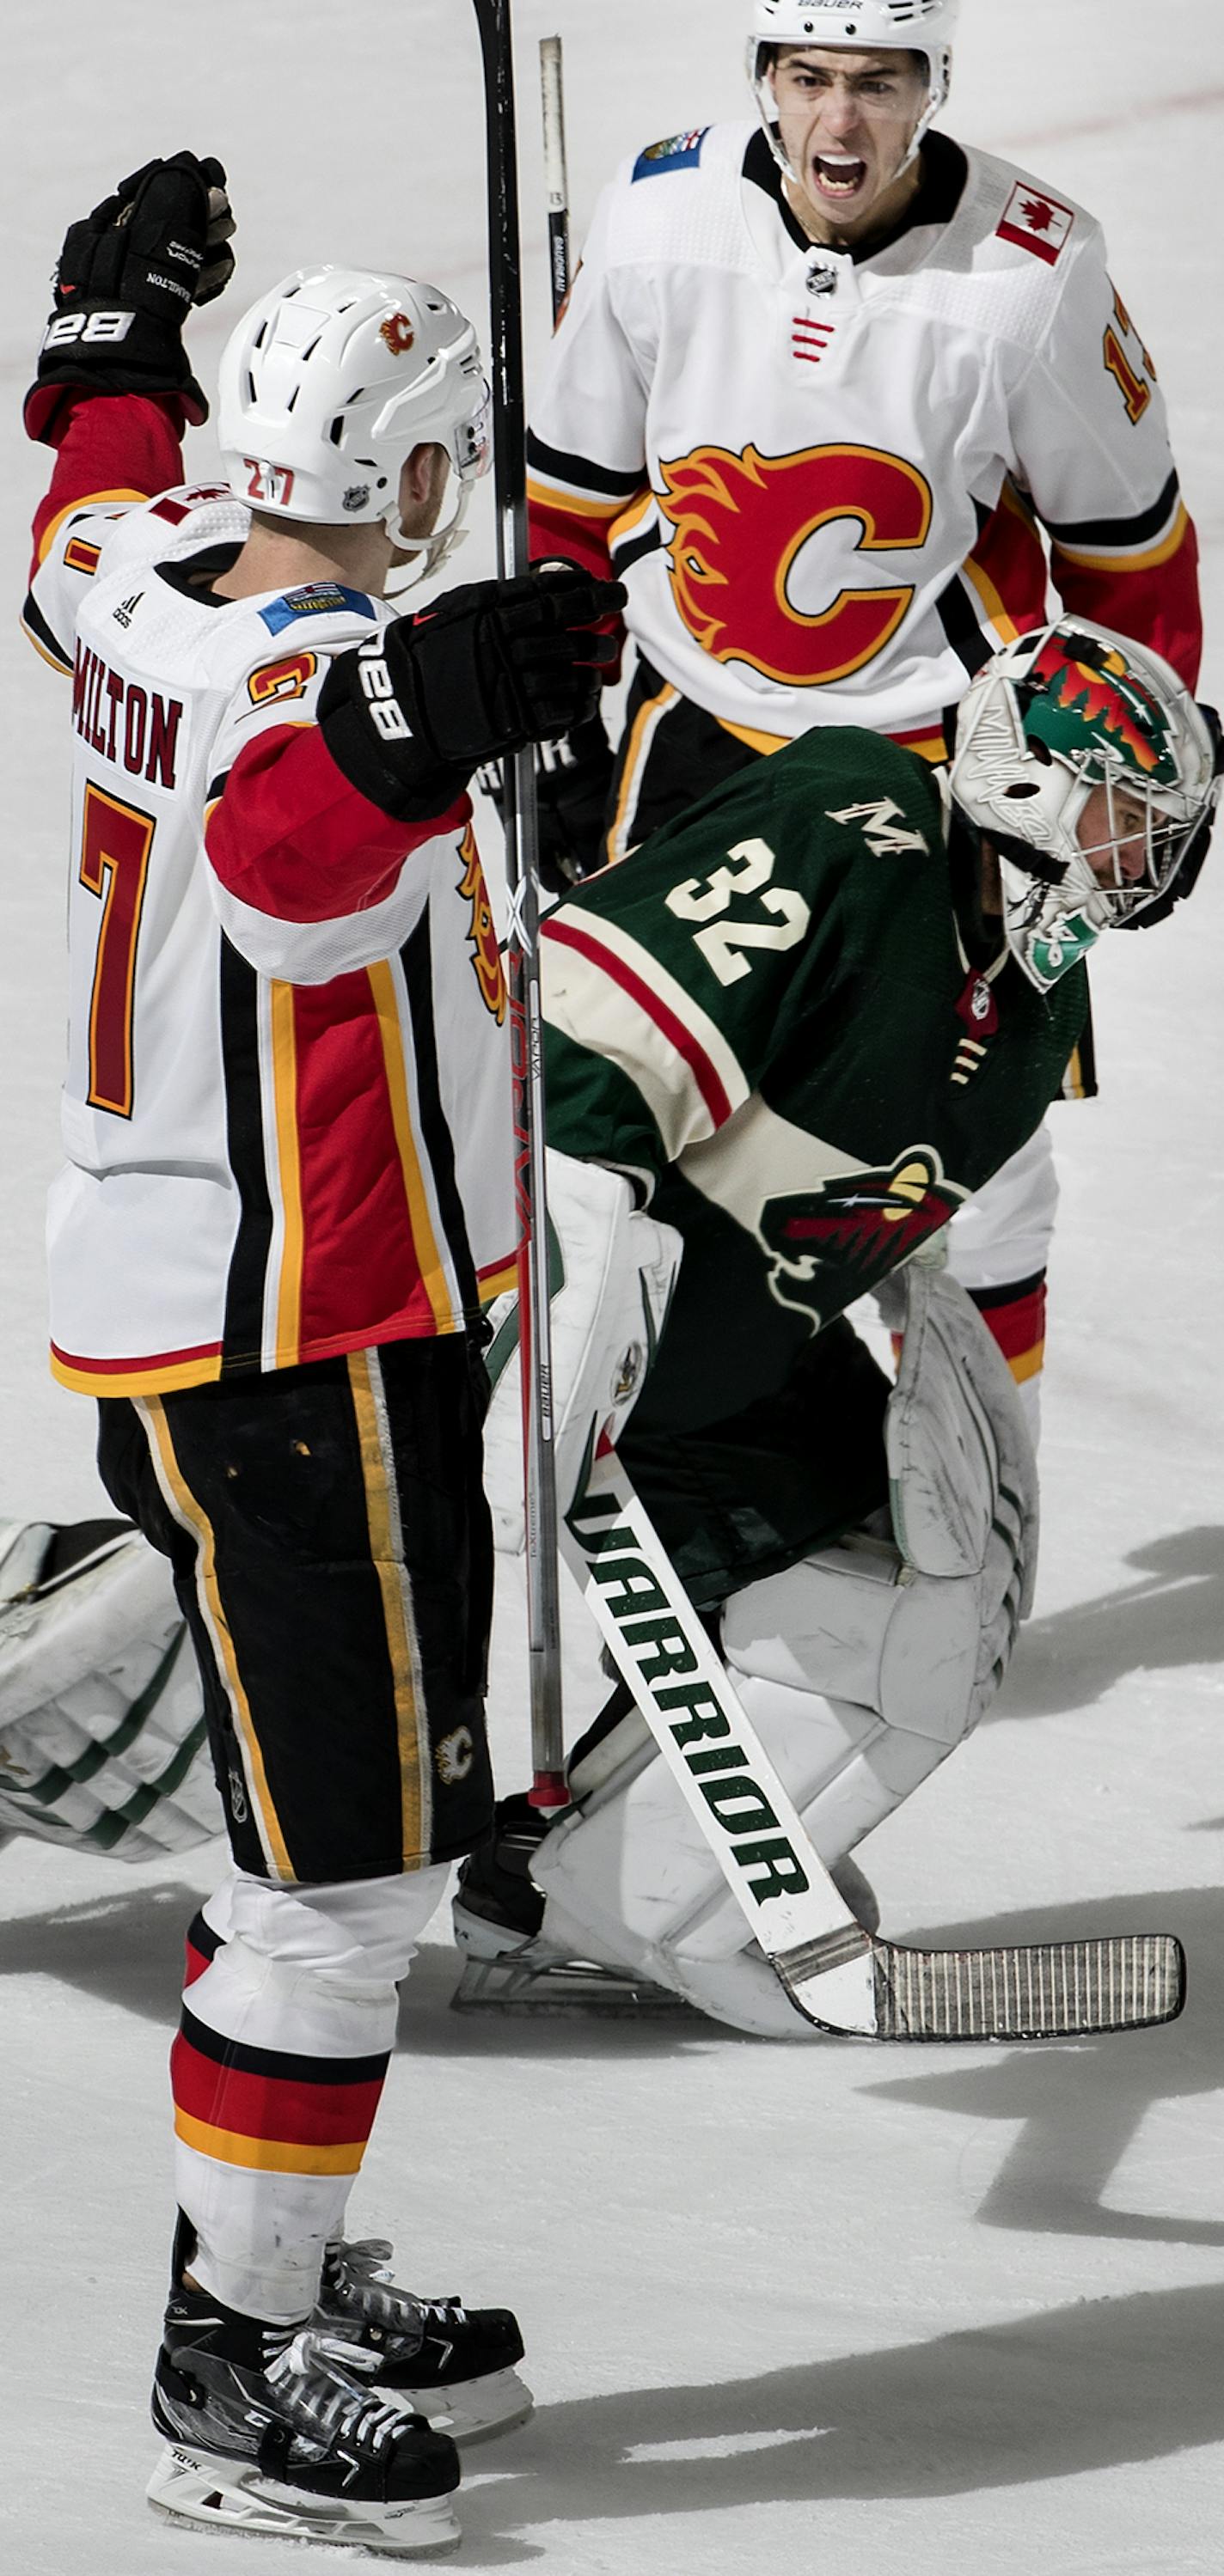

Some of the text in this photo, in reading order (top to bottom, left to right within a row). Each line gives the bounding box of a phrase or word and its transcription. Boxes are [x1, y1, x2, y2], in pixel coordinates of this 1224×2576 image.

[39, 311, 136, 351] BA
[242, 457, 295, 507] 27
[824, 797, 930, 858] M
[664, 837, 811, 987] 32
